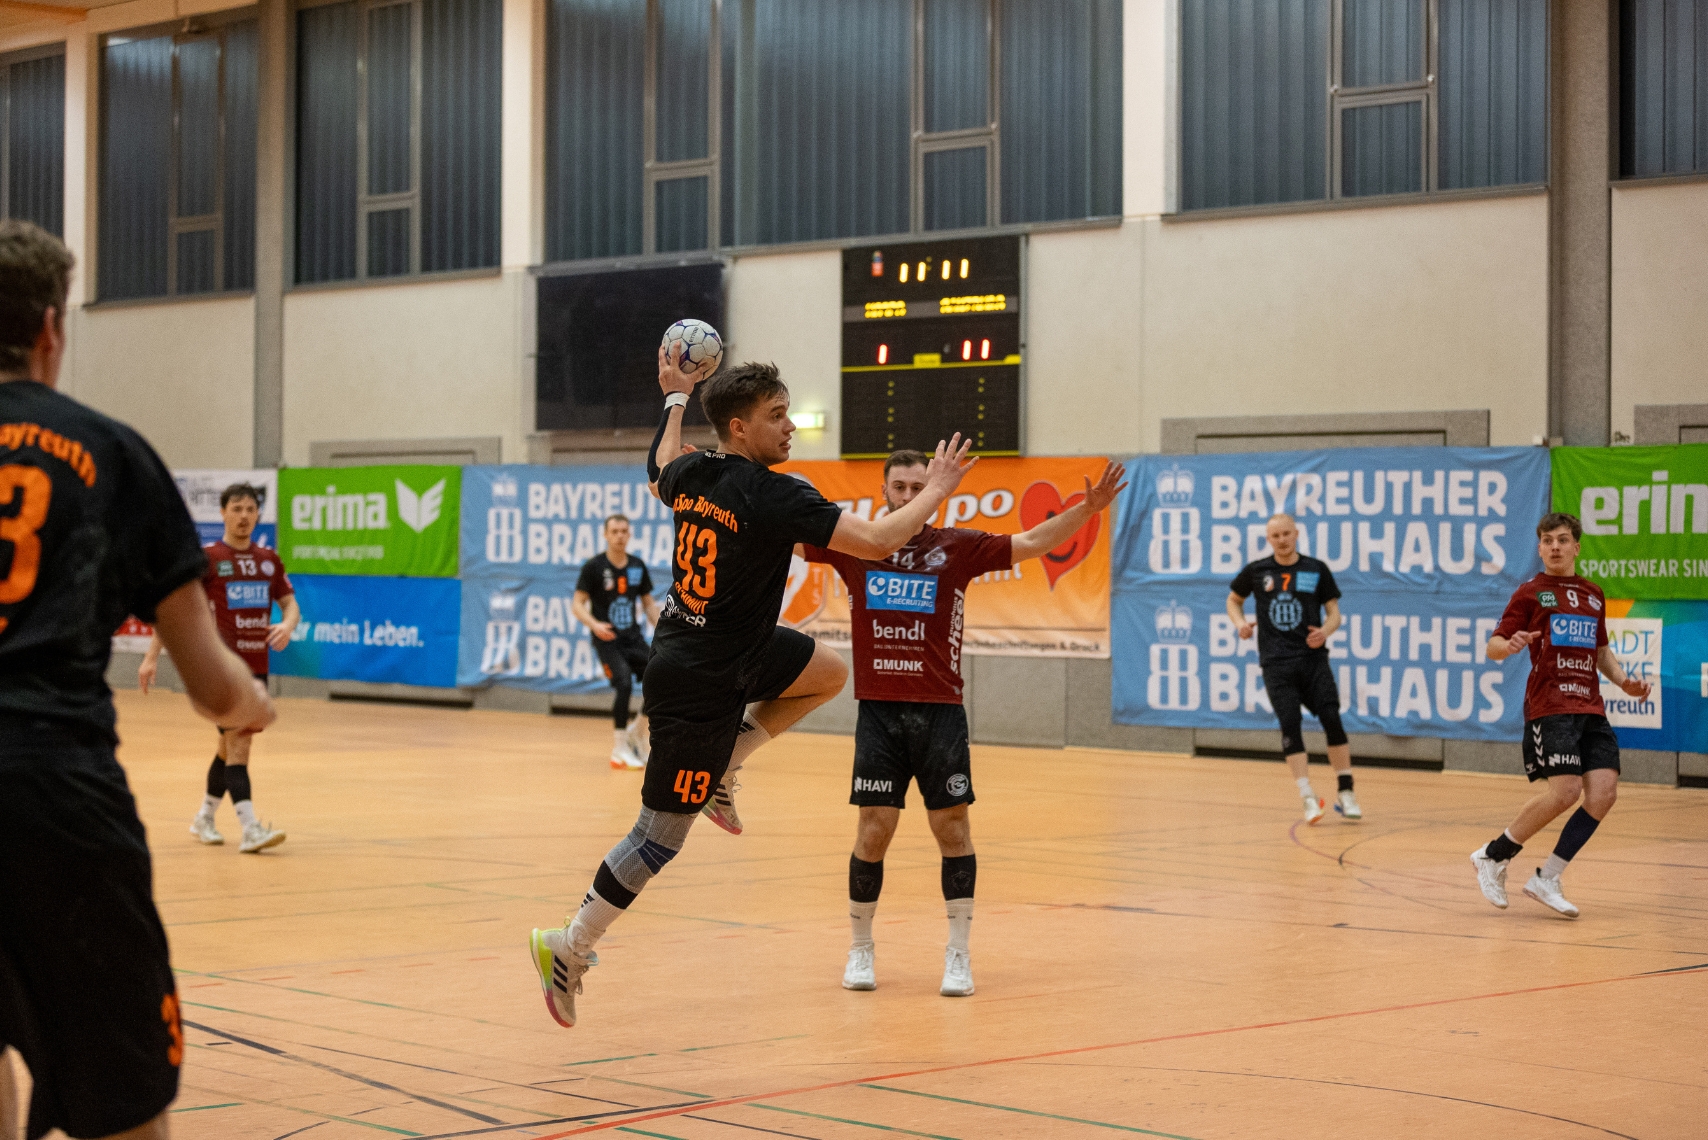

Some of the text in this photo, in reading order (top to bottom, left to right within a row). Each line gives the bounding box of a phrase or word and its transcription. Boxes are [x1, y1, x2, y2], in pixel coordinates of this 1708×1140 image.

[528, 482, 669, 520] BAYREUT
[1211, 470, 1508, 519] BAYREUTHER
[291, 484, 388, 531] erima
[693, 495, 738, 533] Bayreuth
[528, 522, 674, 567] BRAHA
[237, 559, 257, 576] 13
[676, 521, 718, 598] 43
[1580, 559, 1679, 578] SPORTSWEAR
[888, 578, 935, 599] BITE
[1281, 573, 1291, 591] 7
[887, 597, 933, 608] E-RECRUITING
[1566, 589, 1579, 608] 9
[314, 618, 360, 644] mein
[363, 619, 425, 648] Leben.
[872, 619, 925, 641] bendl
[948, 588, 964, 674] scheel
[1569, 620, 1597, 638] BITE
[883, 659, 924, 672] MUNK
[1557, 652, 1593, 671] bendl
[1210, 662, 1504, 724] BRHAUS
[673, 769, 711, 804] 43
[862, 779, 892, 792] HAVI
